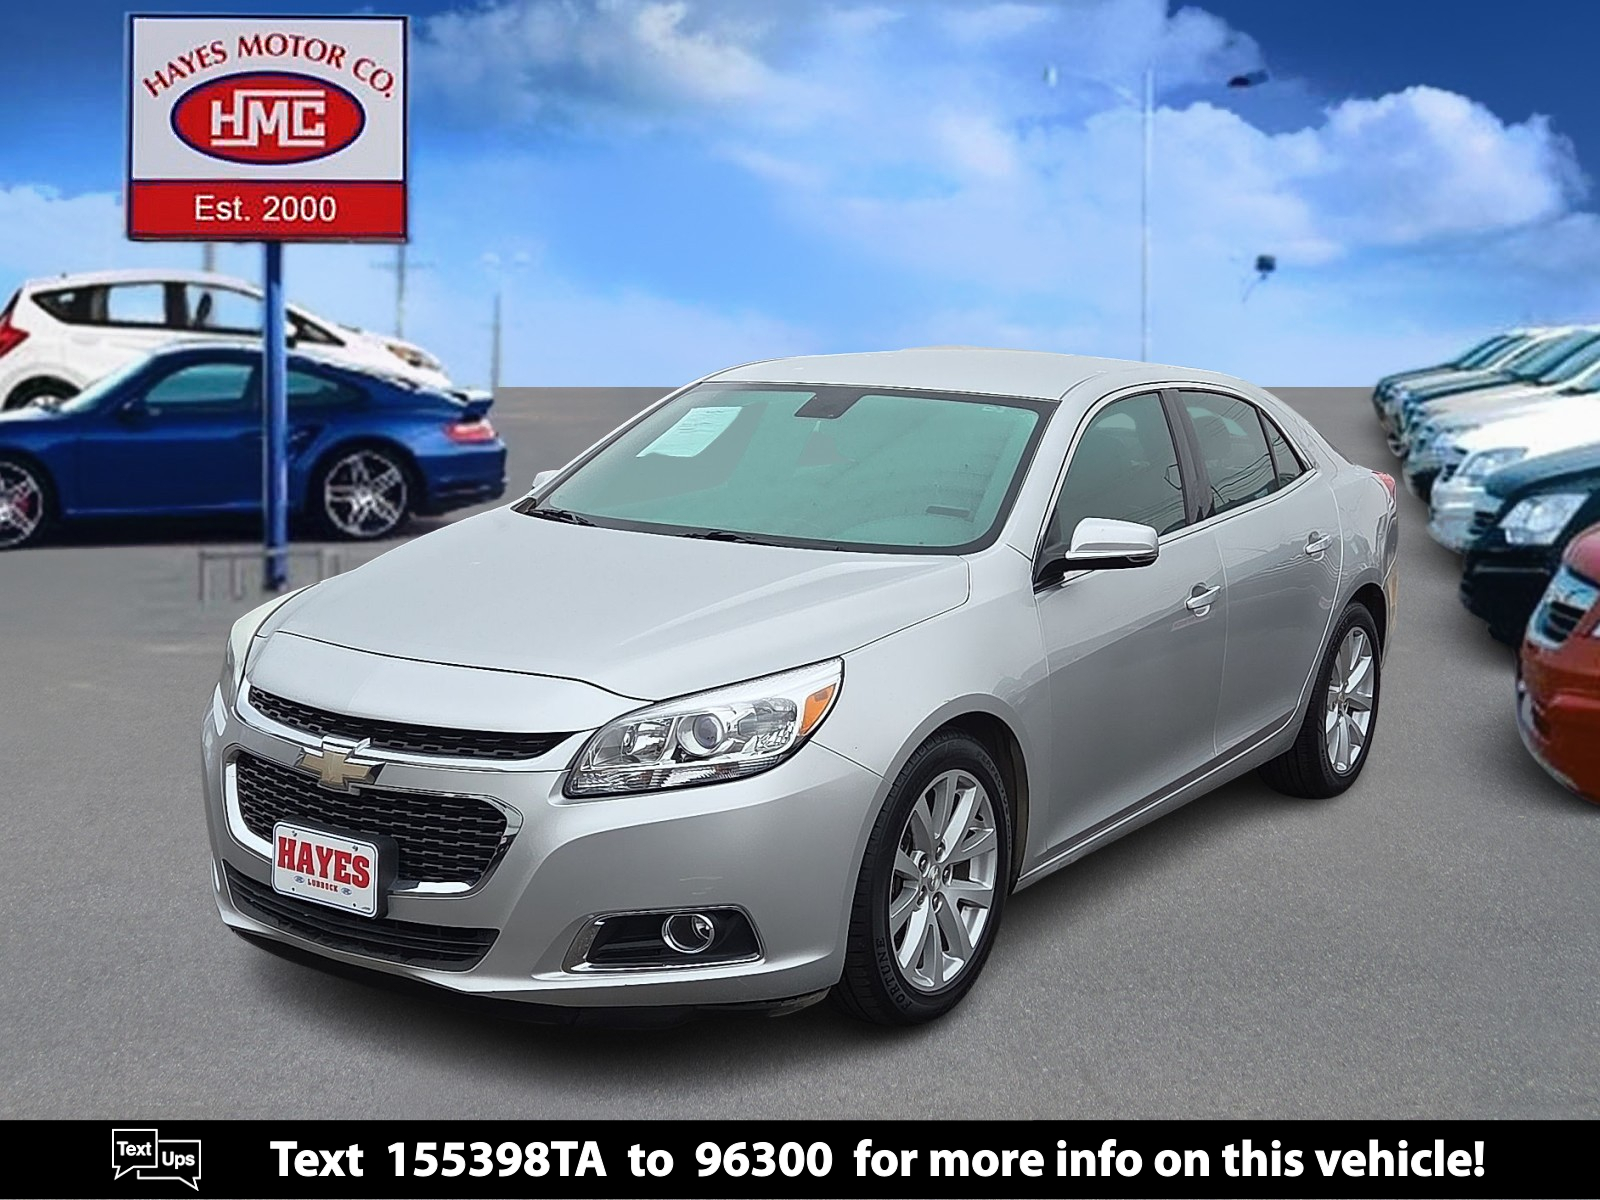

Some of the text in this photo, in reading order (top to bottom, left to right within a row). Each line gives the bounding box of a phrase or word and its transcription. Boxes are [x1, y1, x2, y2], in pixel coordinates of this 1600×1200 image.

[143, 33, 395, 99] HAYES MOTOR CO.
[210, 89, 326, 147] HMC
[194, 195, 337, 223] Est. 2000
[277, 835, 370, 889] HAYES
[876, 936, 913, 1010] FORTUNE
